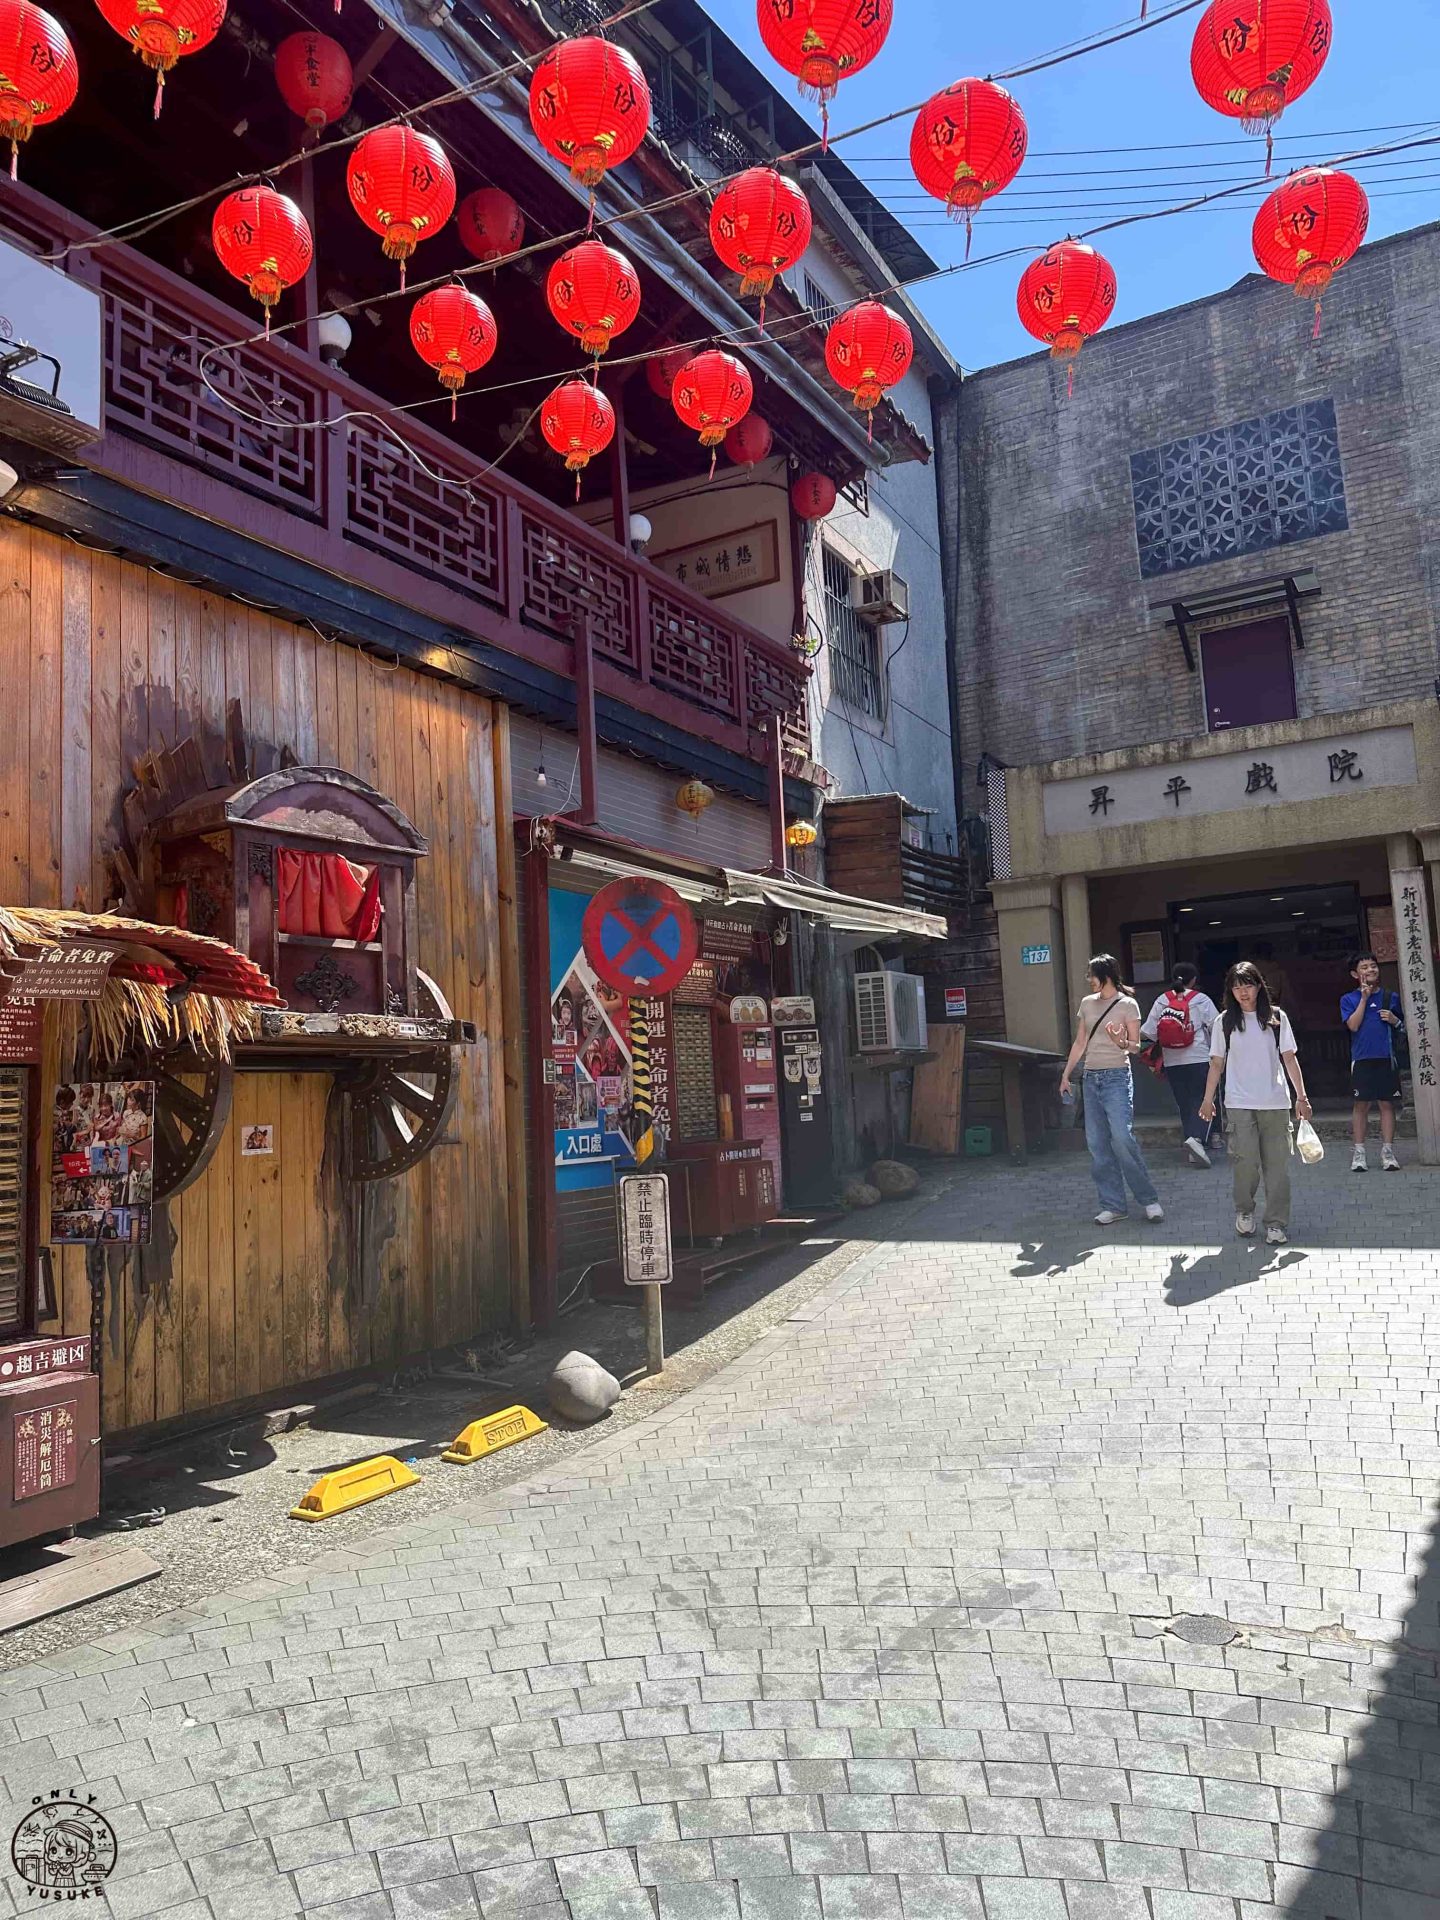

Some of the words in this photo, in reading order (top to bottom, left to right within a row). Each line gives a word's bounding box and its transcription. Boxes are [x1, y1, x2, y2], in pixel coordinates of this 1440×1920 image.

[1088, 750, 1363, 815] 昇平戲院
[1031, 951, 1048, 962] 137
[566, 1134, 602, 1155] 入口處
[637, 1182, 655, 1276] 禁止臨時停車
[486, 1420, 525, 1446] STOP
